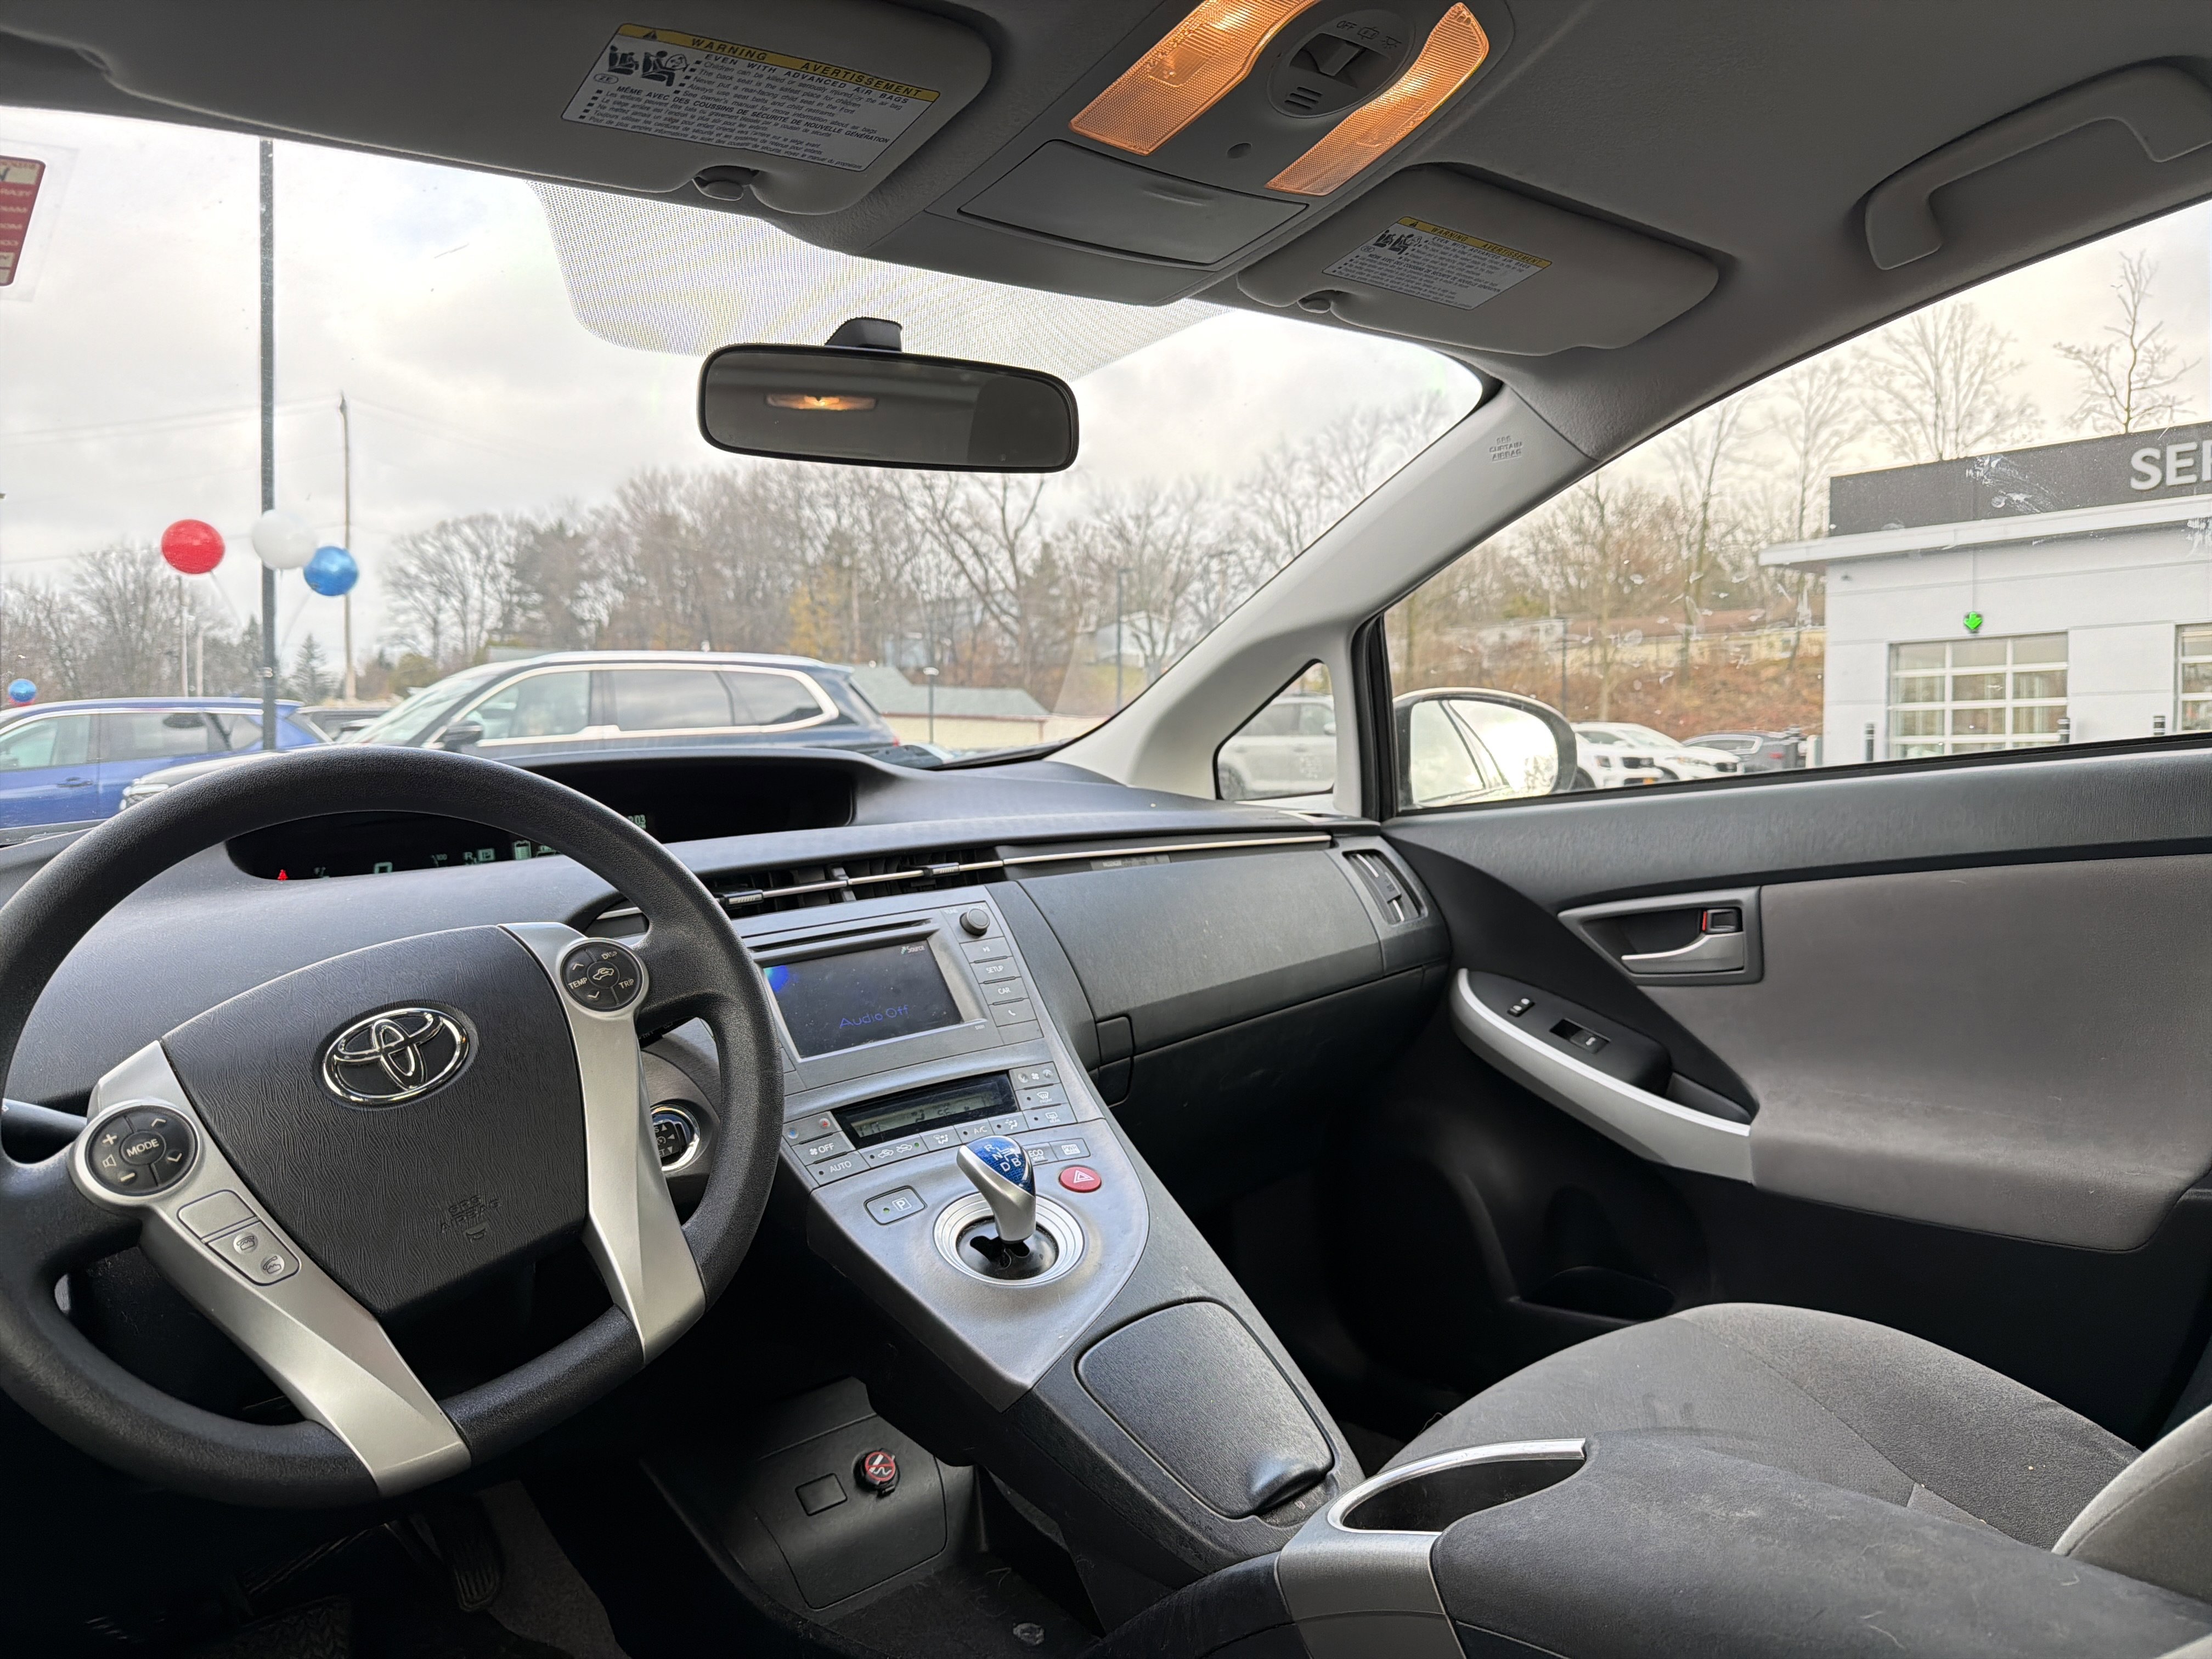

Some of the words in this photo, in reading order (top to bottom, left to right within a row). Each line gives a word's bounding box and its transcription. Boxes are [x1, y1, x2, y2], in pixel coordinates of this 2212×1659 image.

[689, 37, 769, 61] WARNING
[702, 61, 736, 72] Children
[765, 75, 786, 83] killed
[795, 82, 828, 93] seriously
[828, 88, 854, 98] injured
[704, 54, 739, 65] EVEN
[745, 62, 777, 73] WITH
[783, 70, 848, 88] ADVANCED
[852, 86, 874, 95] AIR
[878, 93, 911, 104] BAGS
[799, 61, 922, 97] AVERTISSEMENT
[692, 76, 716, 85] Never
[740, 86, 780, 99] rear-facing
[779, 94, 799, 102] child
[715, 72, 735, 81] back
[778, 86, 802, 94] safest
[800, 91, 822, 99] place
[833, 98, 863, 108] children
[686, 83, 715, 94] Always
[804, 107, 836, 117] restraints
[615, 84, 645, 95] MÊME
[645, 91, 670, 100] AVEC
[672, 96, 691, 104] DES
[692, 100, 735, 112] COUSSINS
[749, 110, 790, 122] SÉCURITÉ
[802, 121, 844, 133] NOUVELLE
[843, 129, 892, 143] GÉNÉRATION
[699, 93, 730, 104] owner's
[730, 99, 758, 109] manual
[791, 111, 830, 123] information
[828, 120, 850, 128] about
[1428, 227, 1470, 242] WARNING
[1467, 247, 1502, 259] ADVANCED
[1479, 242, 1543, 264] AVERTISSEMENT
[1492, 448, 1522, 461] AIRBAG
[601, 951, 617, 960] DISP
[986, 965, 1004, 974] SETUP
[568, 977, 588, 989] TEMP
[618, 979, 634, 989] TRIP
[839, 1013, 883, 1028] Audio
[886, 1005, 909, 1018] Off
[974, 1126, 988, 1135] A/C
[126, 1138, 160, 1157] MODE
[818, 1143, 834, 1153] OFF
[992, 1153, 1002, 1161] N
[1012, 1158, 1022, 1167] B
[829, 1160, 852, 1173] AUTO
[1000, 1162, 1011, 1172] D
